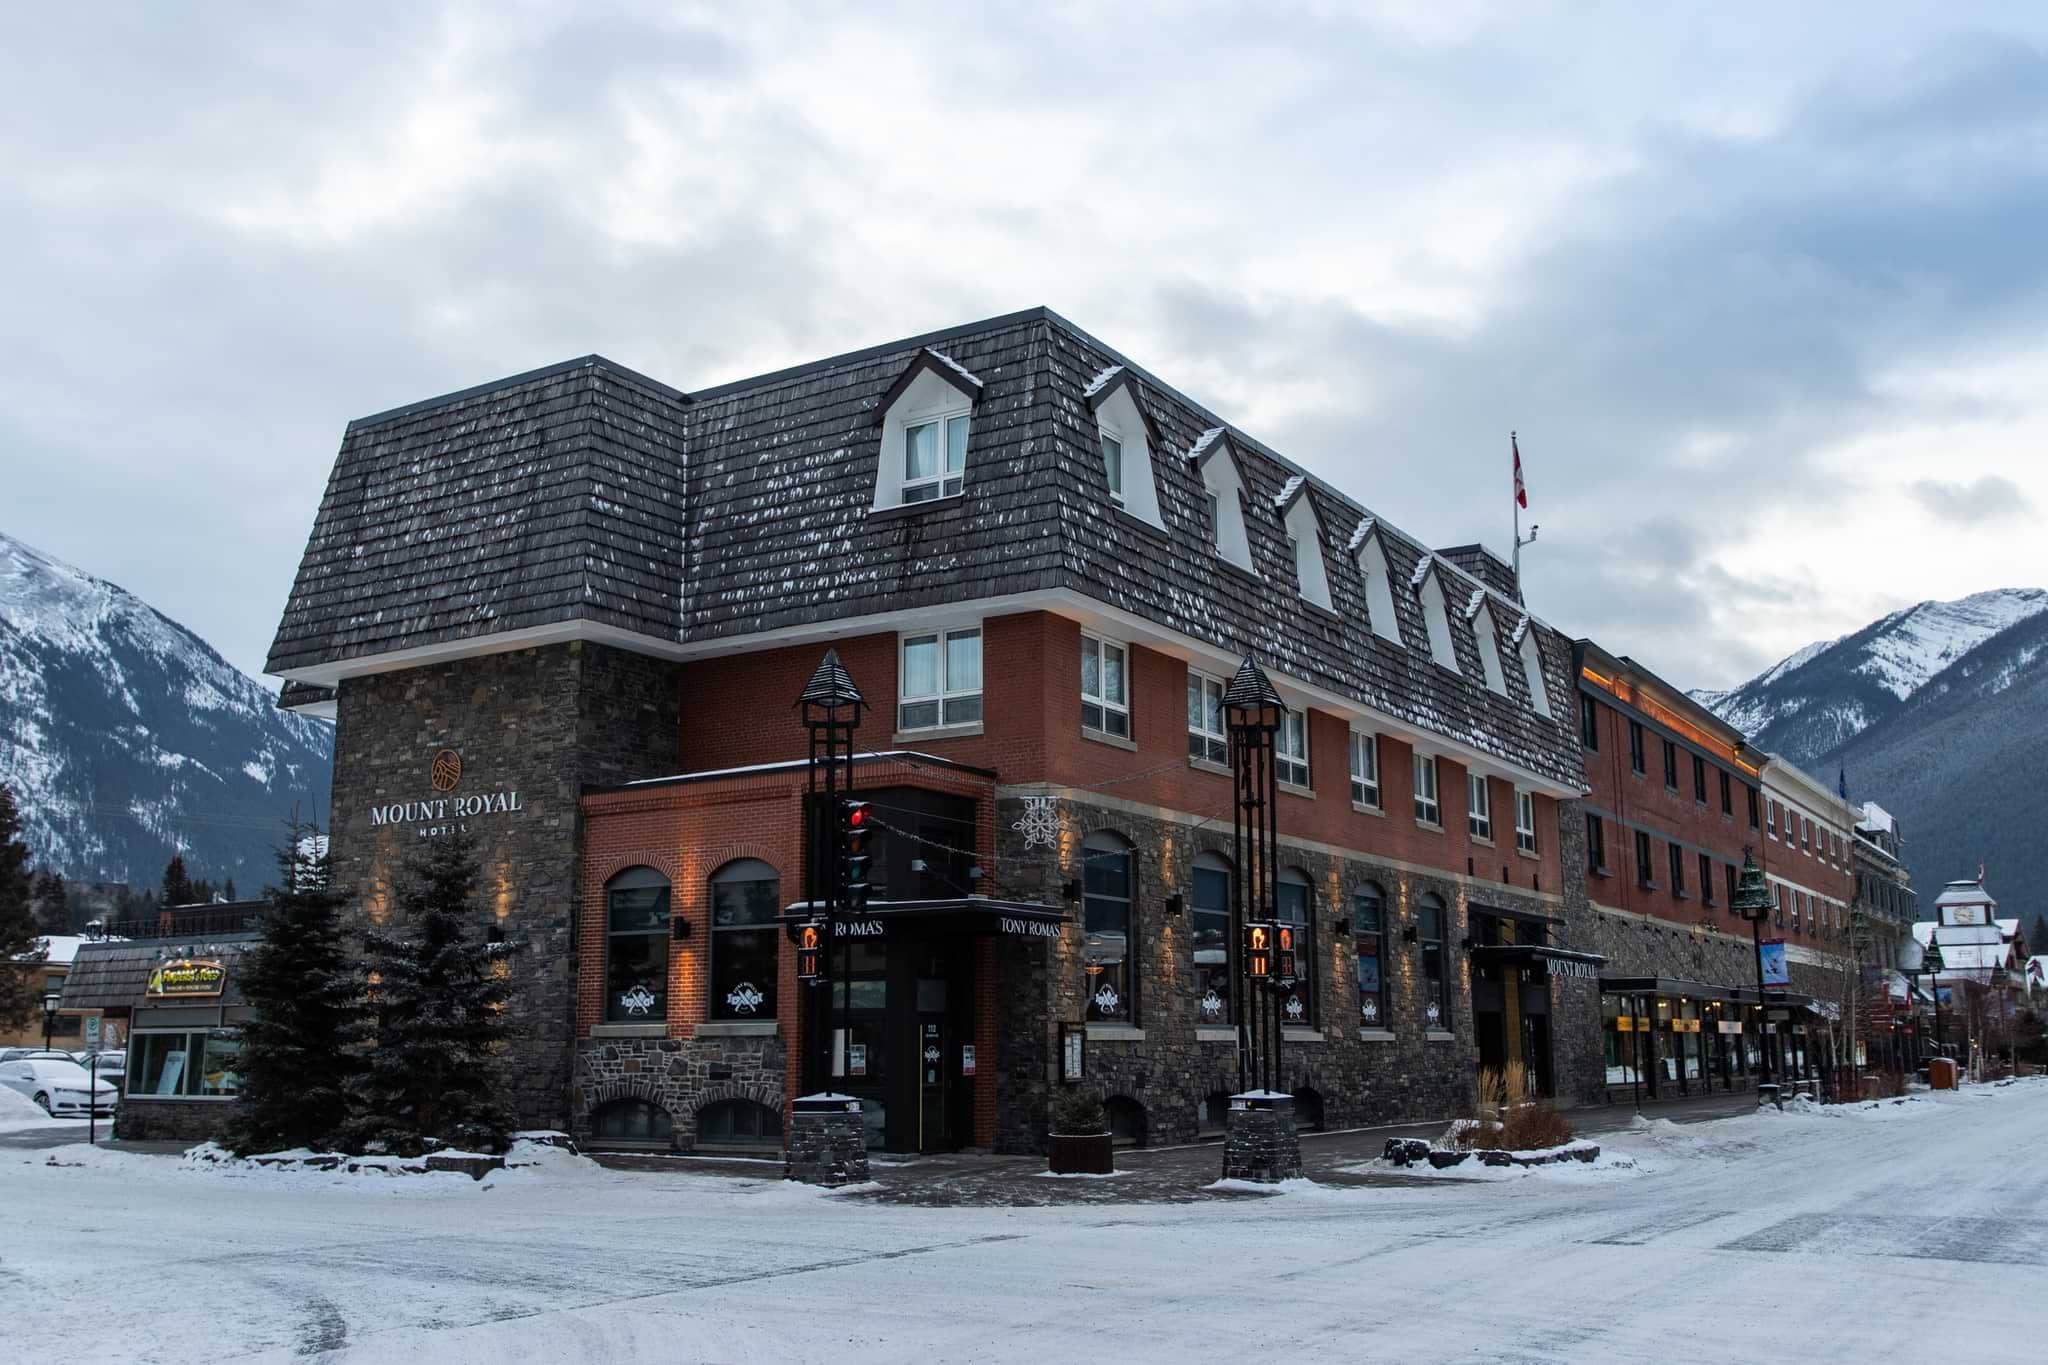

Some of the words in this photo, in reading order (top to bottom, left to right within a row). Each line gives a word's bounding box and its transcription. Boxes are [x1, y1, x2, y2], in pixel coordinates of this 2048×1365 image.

[371, 799, 449, 825] MOUNT
[453, 791, 522, 817] ROYAL
[1000, 917, 1028, 935] TONY
[1545, 958, 1574, 977] MOUNT
